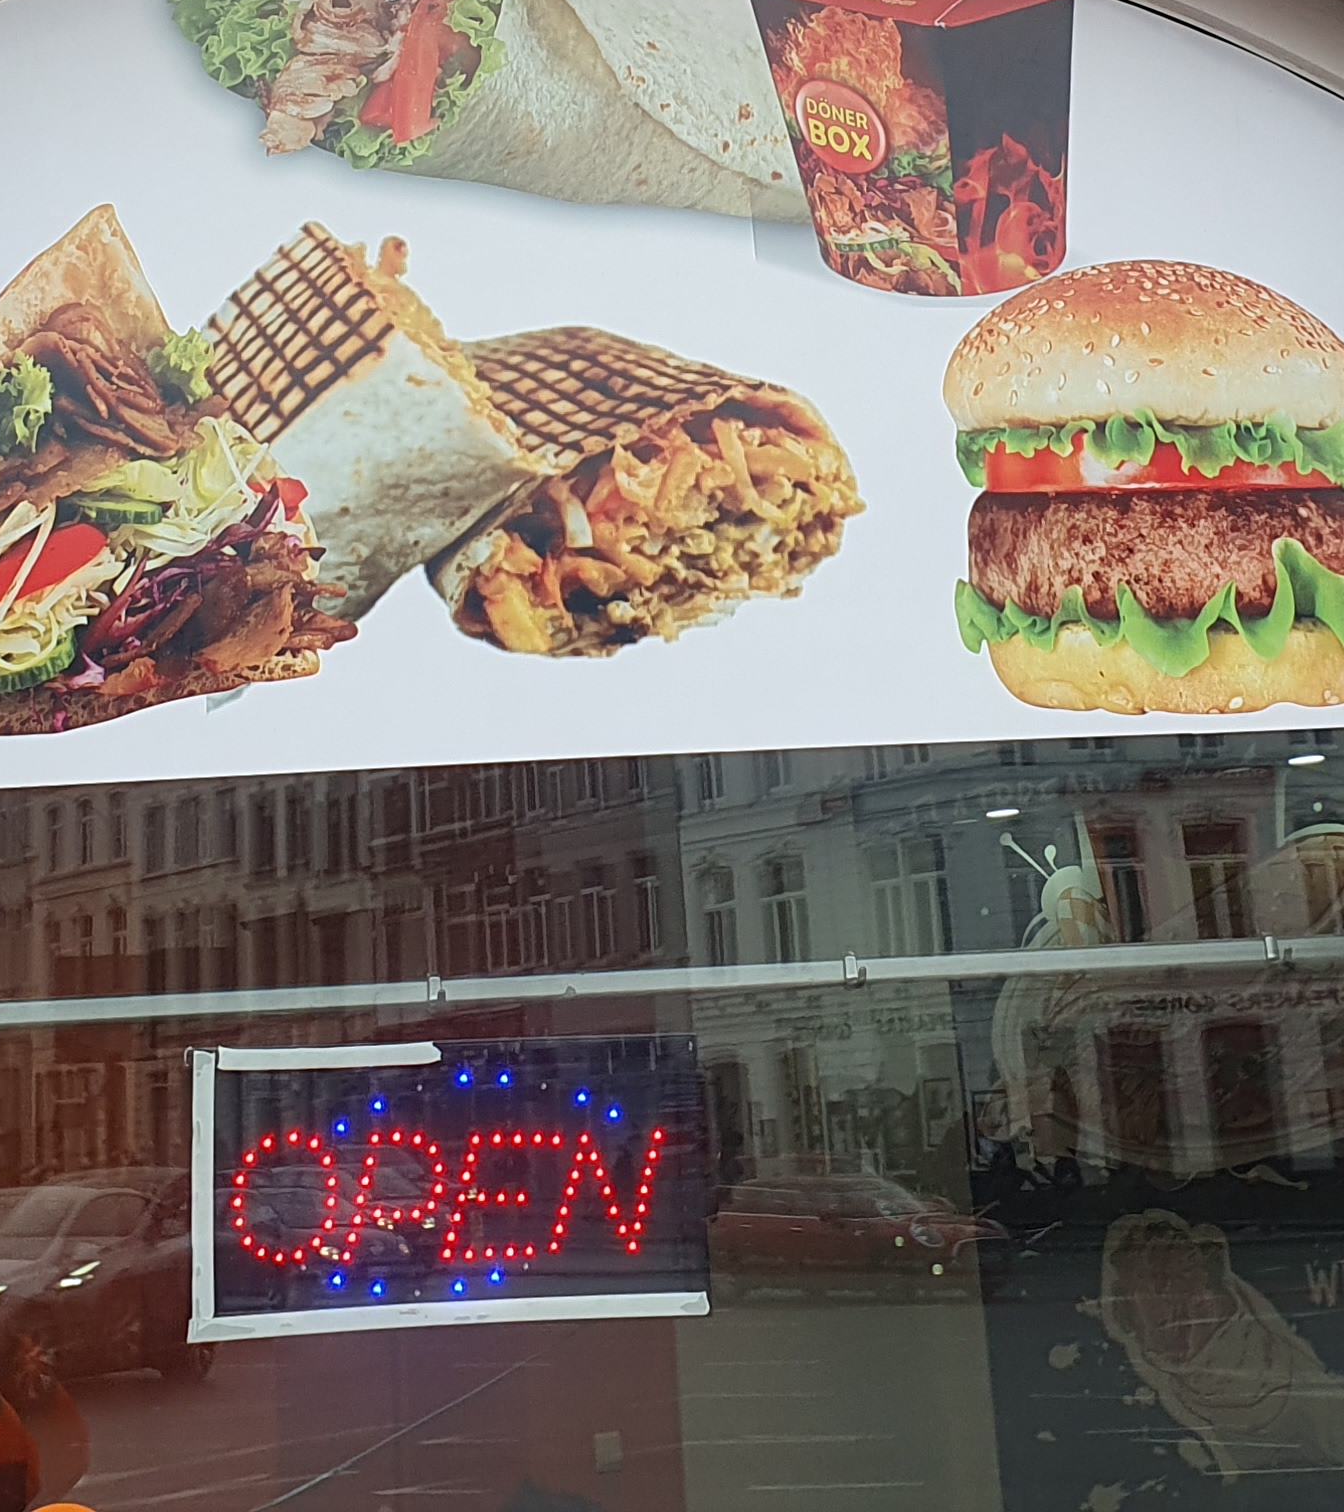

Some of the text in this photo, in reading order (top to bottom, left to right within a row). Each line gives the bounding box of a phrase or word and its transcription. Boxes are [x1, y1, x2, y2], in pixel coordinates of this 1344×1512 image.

[806, 97, 868, 130] DÖNER
[807, 117, 873, 161] BOX
[229, 1126, 666, 1266] OPEN
